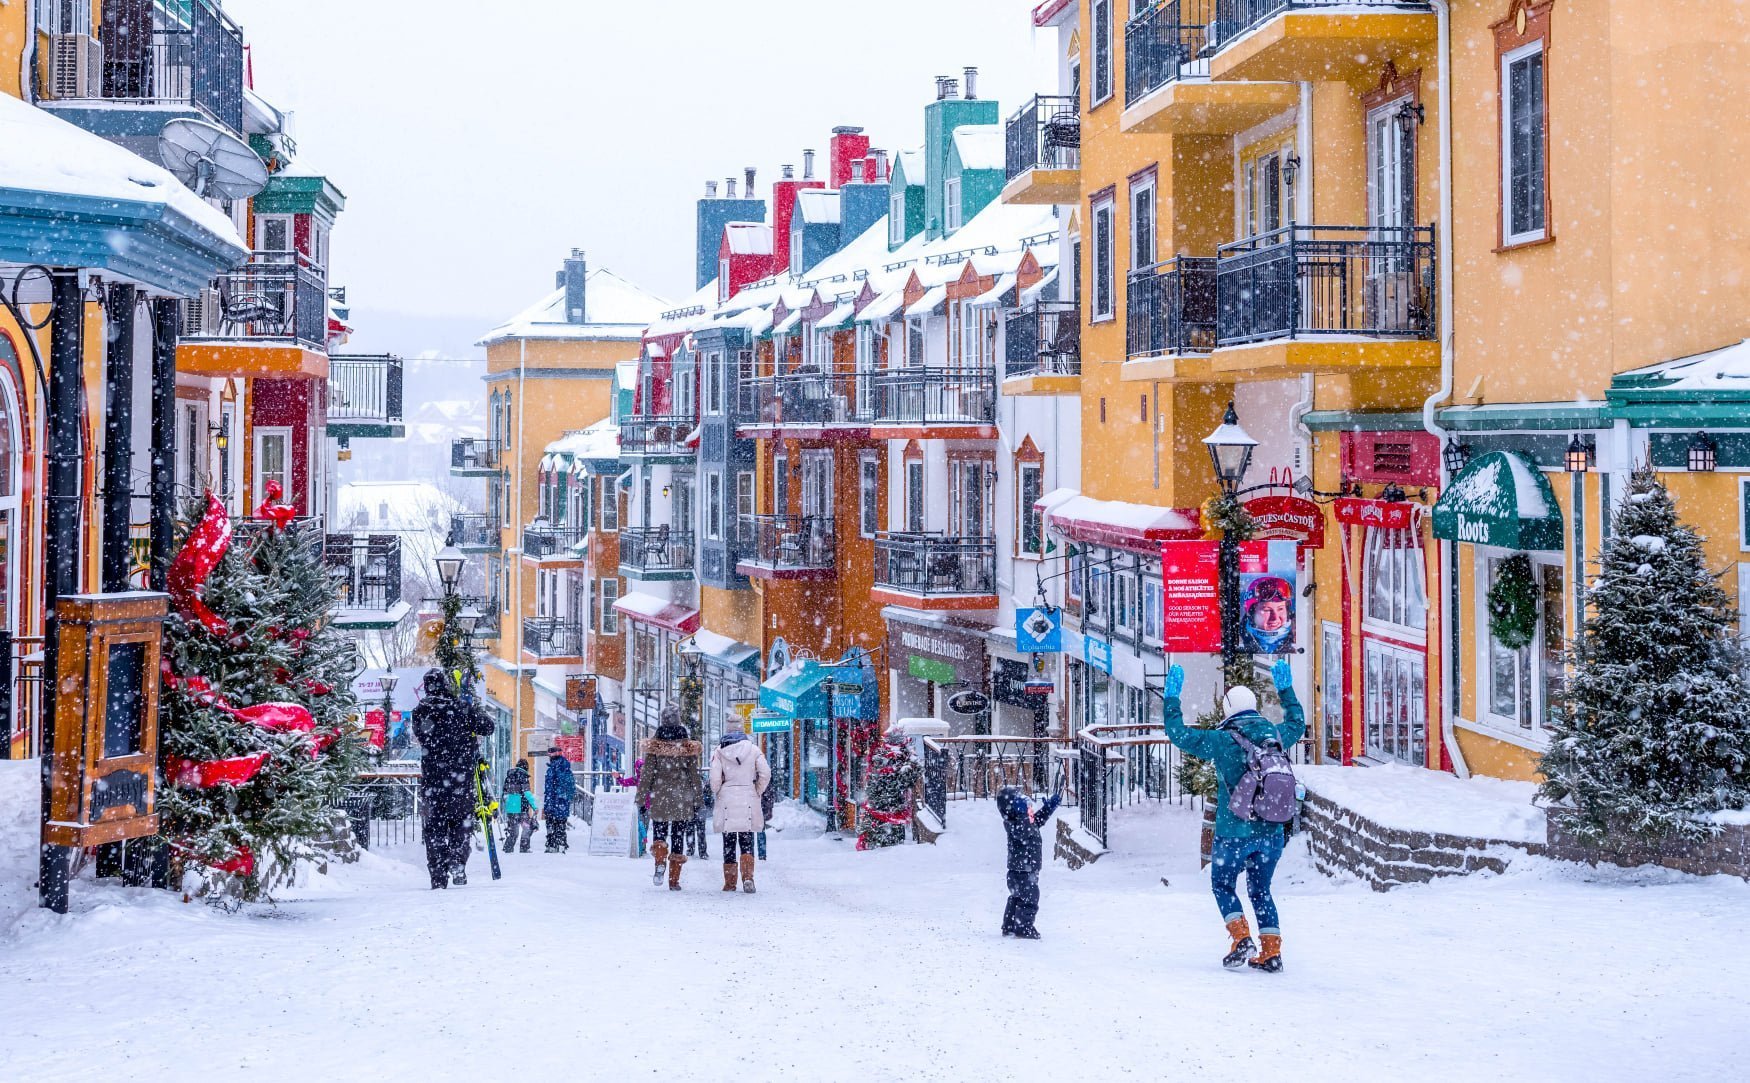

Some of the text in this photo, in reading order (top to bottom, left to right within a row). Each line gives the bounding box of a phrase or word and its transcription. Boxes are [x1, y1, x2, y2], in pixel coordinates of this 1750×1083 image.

[1283, 512, 1315, 529] CASTOR
[1457, 513, 1489, 543] Roots
[1022, 643, 1056, 651] Columbia
